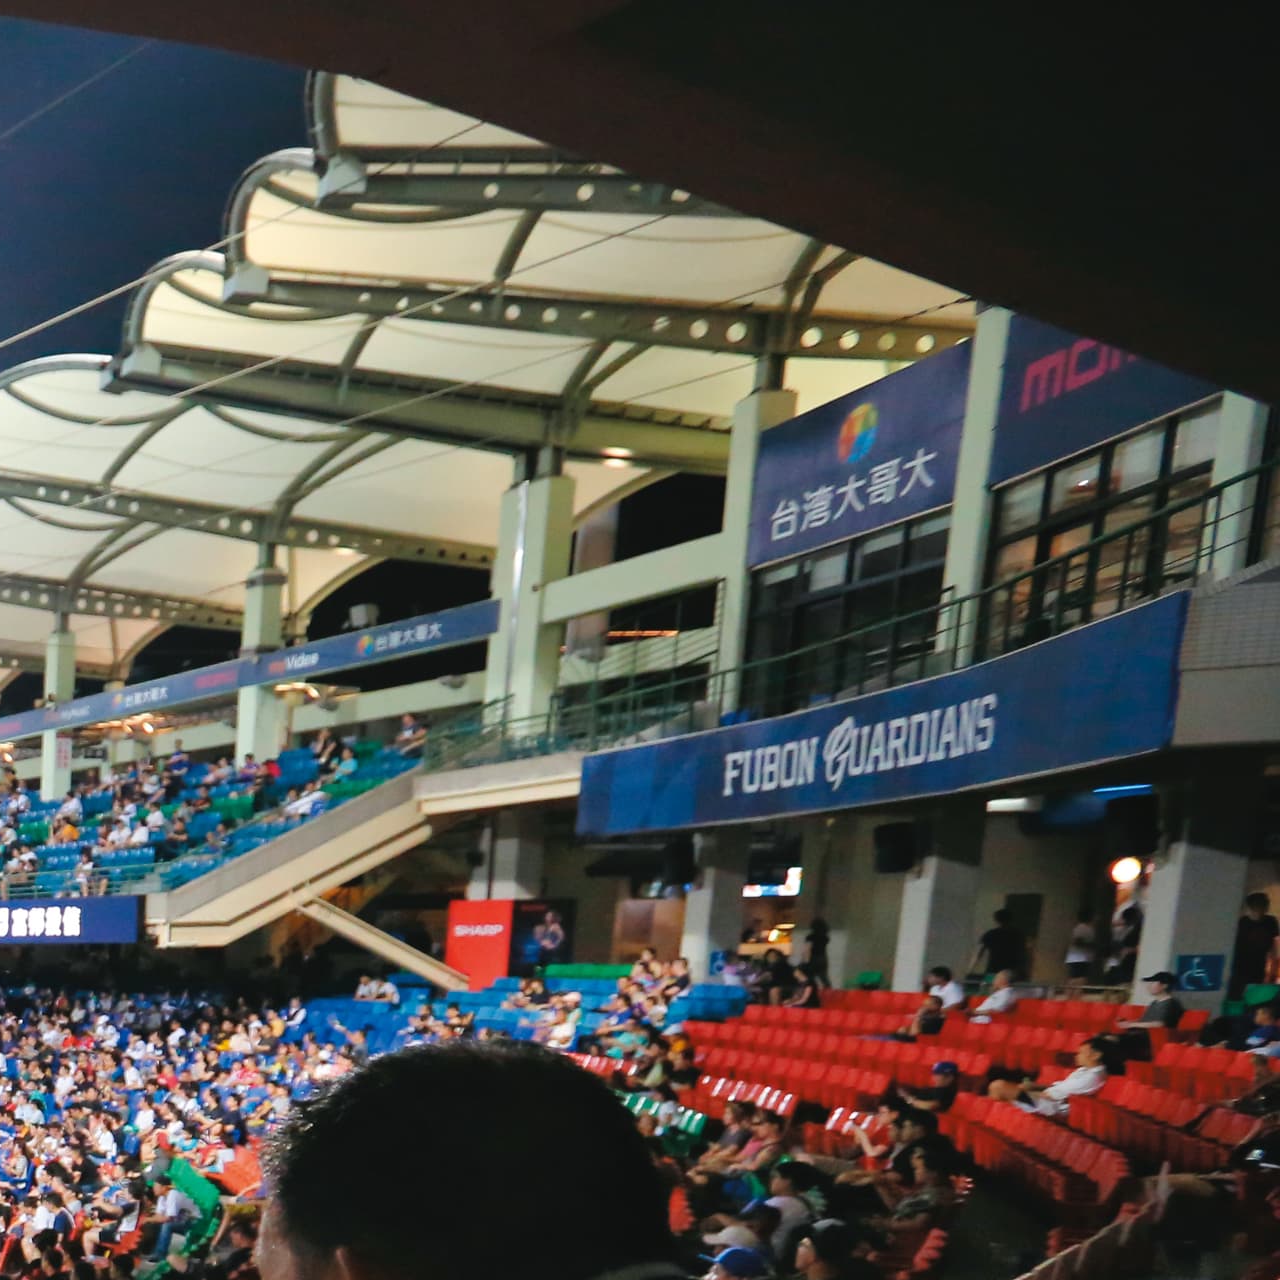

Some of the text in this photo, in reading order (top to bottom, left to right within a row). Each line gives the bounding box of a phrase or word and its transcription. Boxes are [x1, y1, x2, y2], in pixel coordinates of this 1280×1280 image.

[722, 693, 998, 797] FUBON GUARDIANS
[454, 924, 504, 937] SHARP
